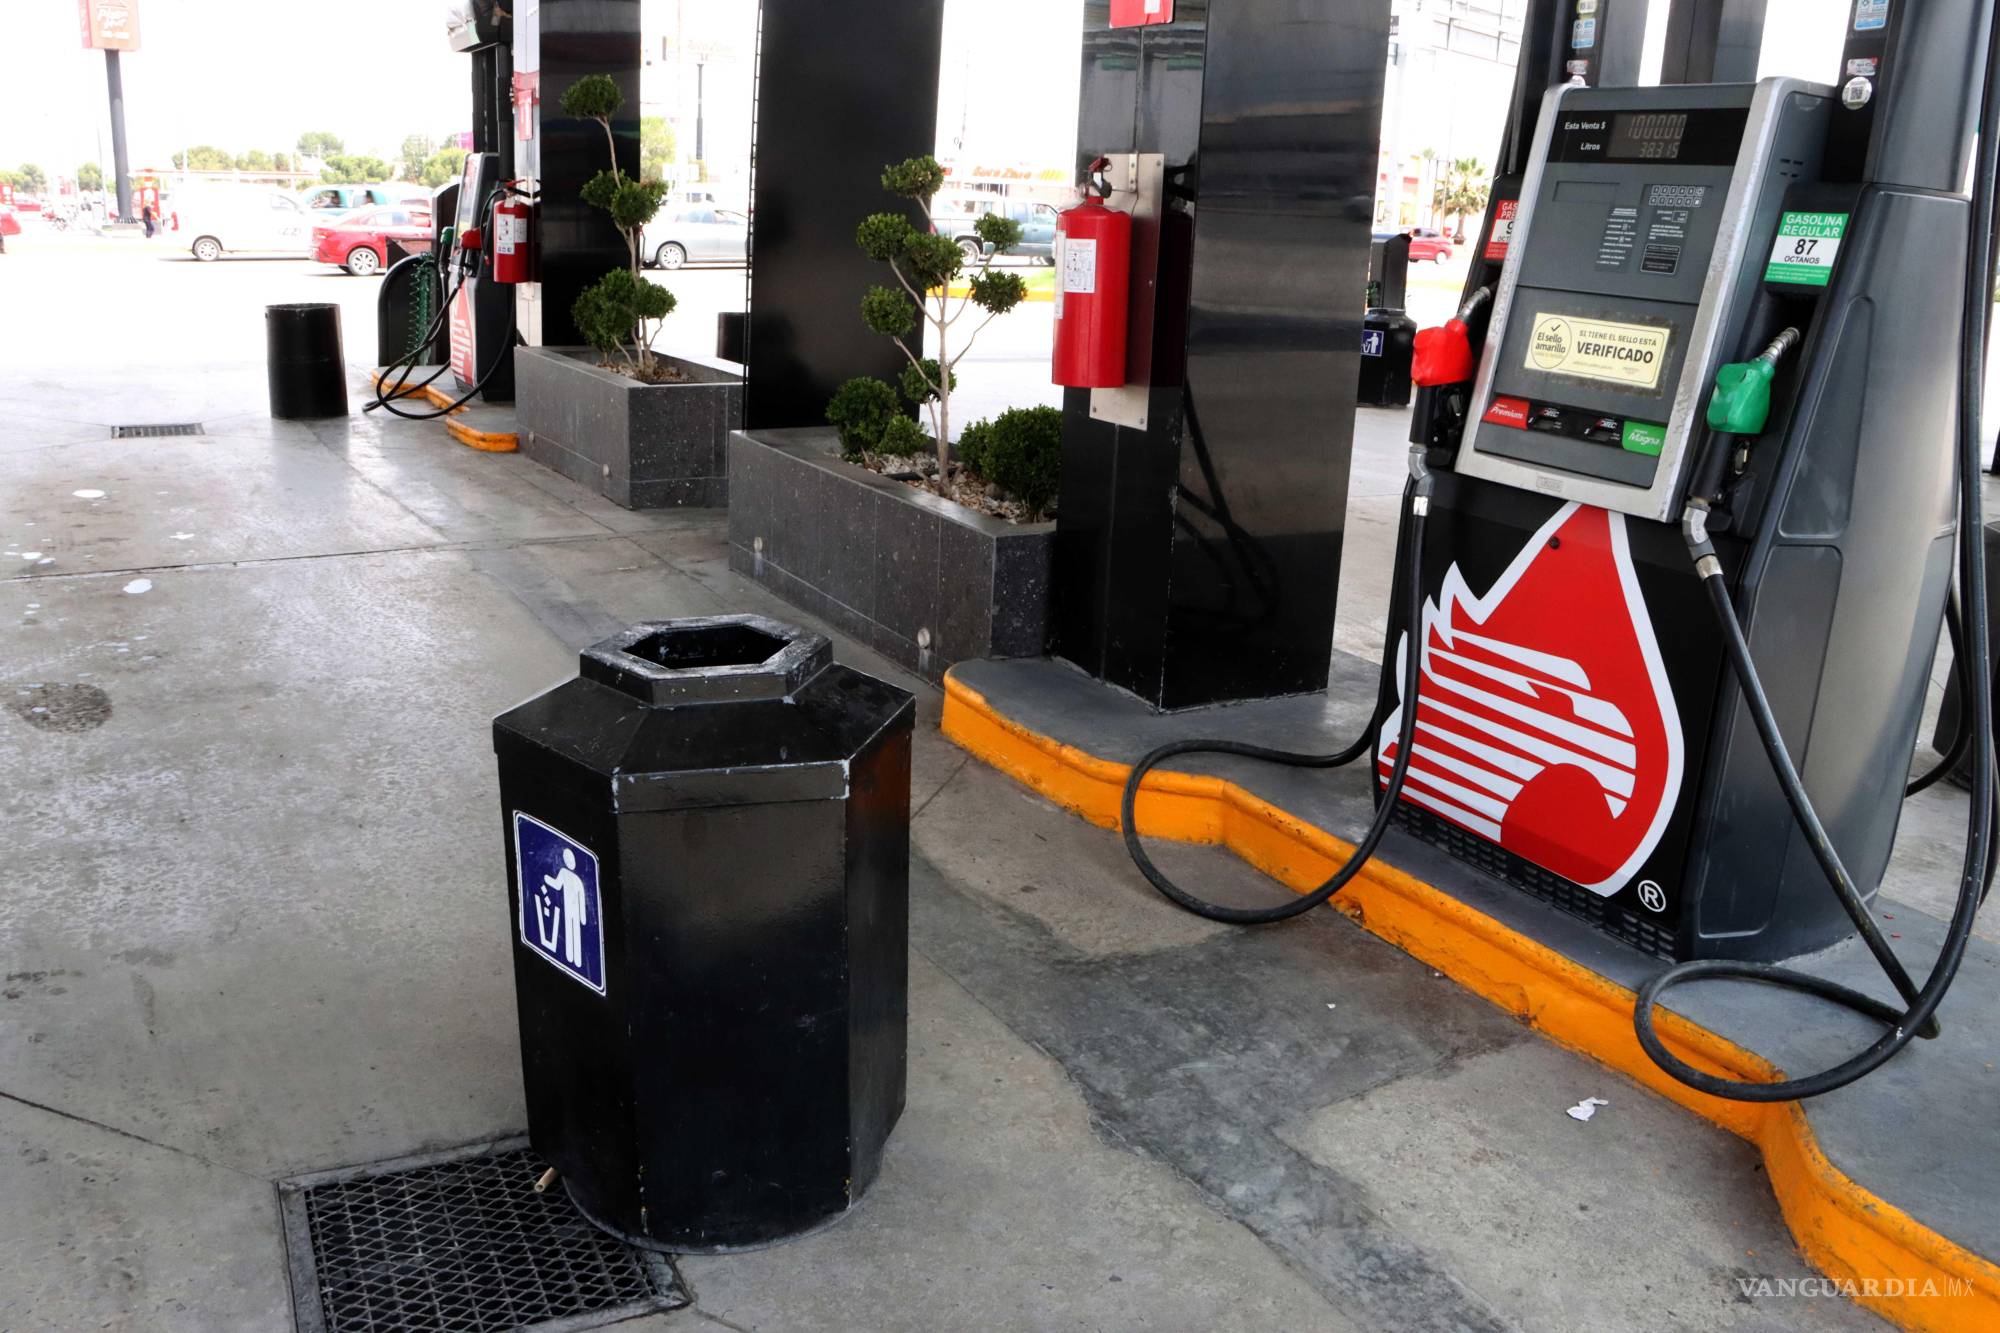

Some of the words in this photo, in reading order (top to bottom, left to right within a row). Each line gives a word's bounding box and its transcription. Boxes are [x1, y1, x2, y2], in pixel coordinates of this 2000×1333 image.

[1564, 121, 1579, 130] Esta
[1581, 121, 1600, 130] Venta
[1601, 121, 1606, 130] $
[1580, 142, 1600, 150] Litros
[1785, 214, 1843, 226] GASOLINA
[1782, 224, 1840, 237] REGULAR
[1794, 238, 1818, 255] 87
[1784, 255, 1820, 264] OCTANOS
[1537, 332, 1545, 342] El
[1545, 333, 1563, 343] sello
[1588, 331, 1607, 341] TIENE
[1608, 333, 1617, 342] EL
[1618, 335, 1637, 344] SELLO
[1535, 342, 1566, 354] amarillo
[1577, 340, 1654, 364] VERIFICADO
[1490, 405, 1524, 420] Premium
[1628, 431, 1660, 446] Magna
